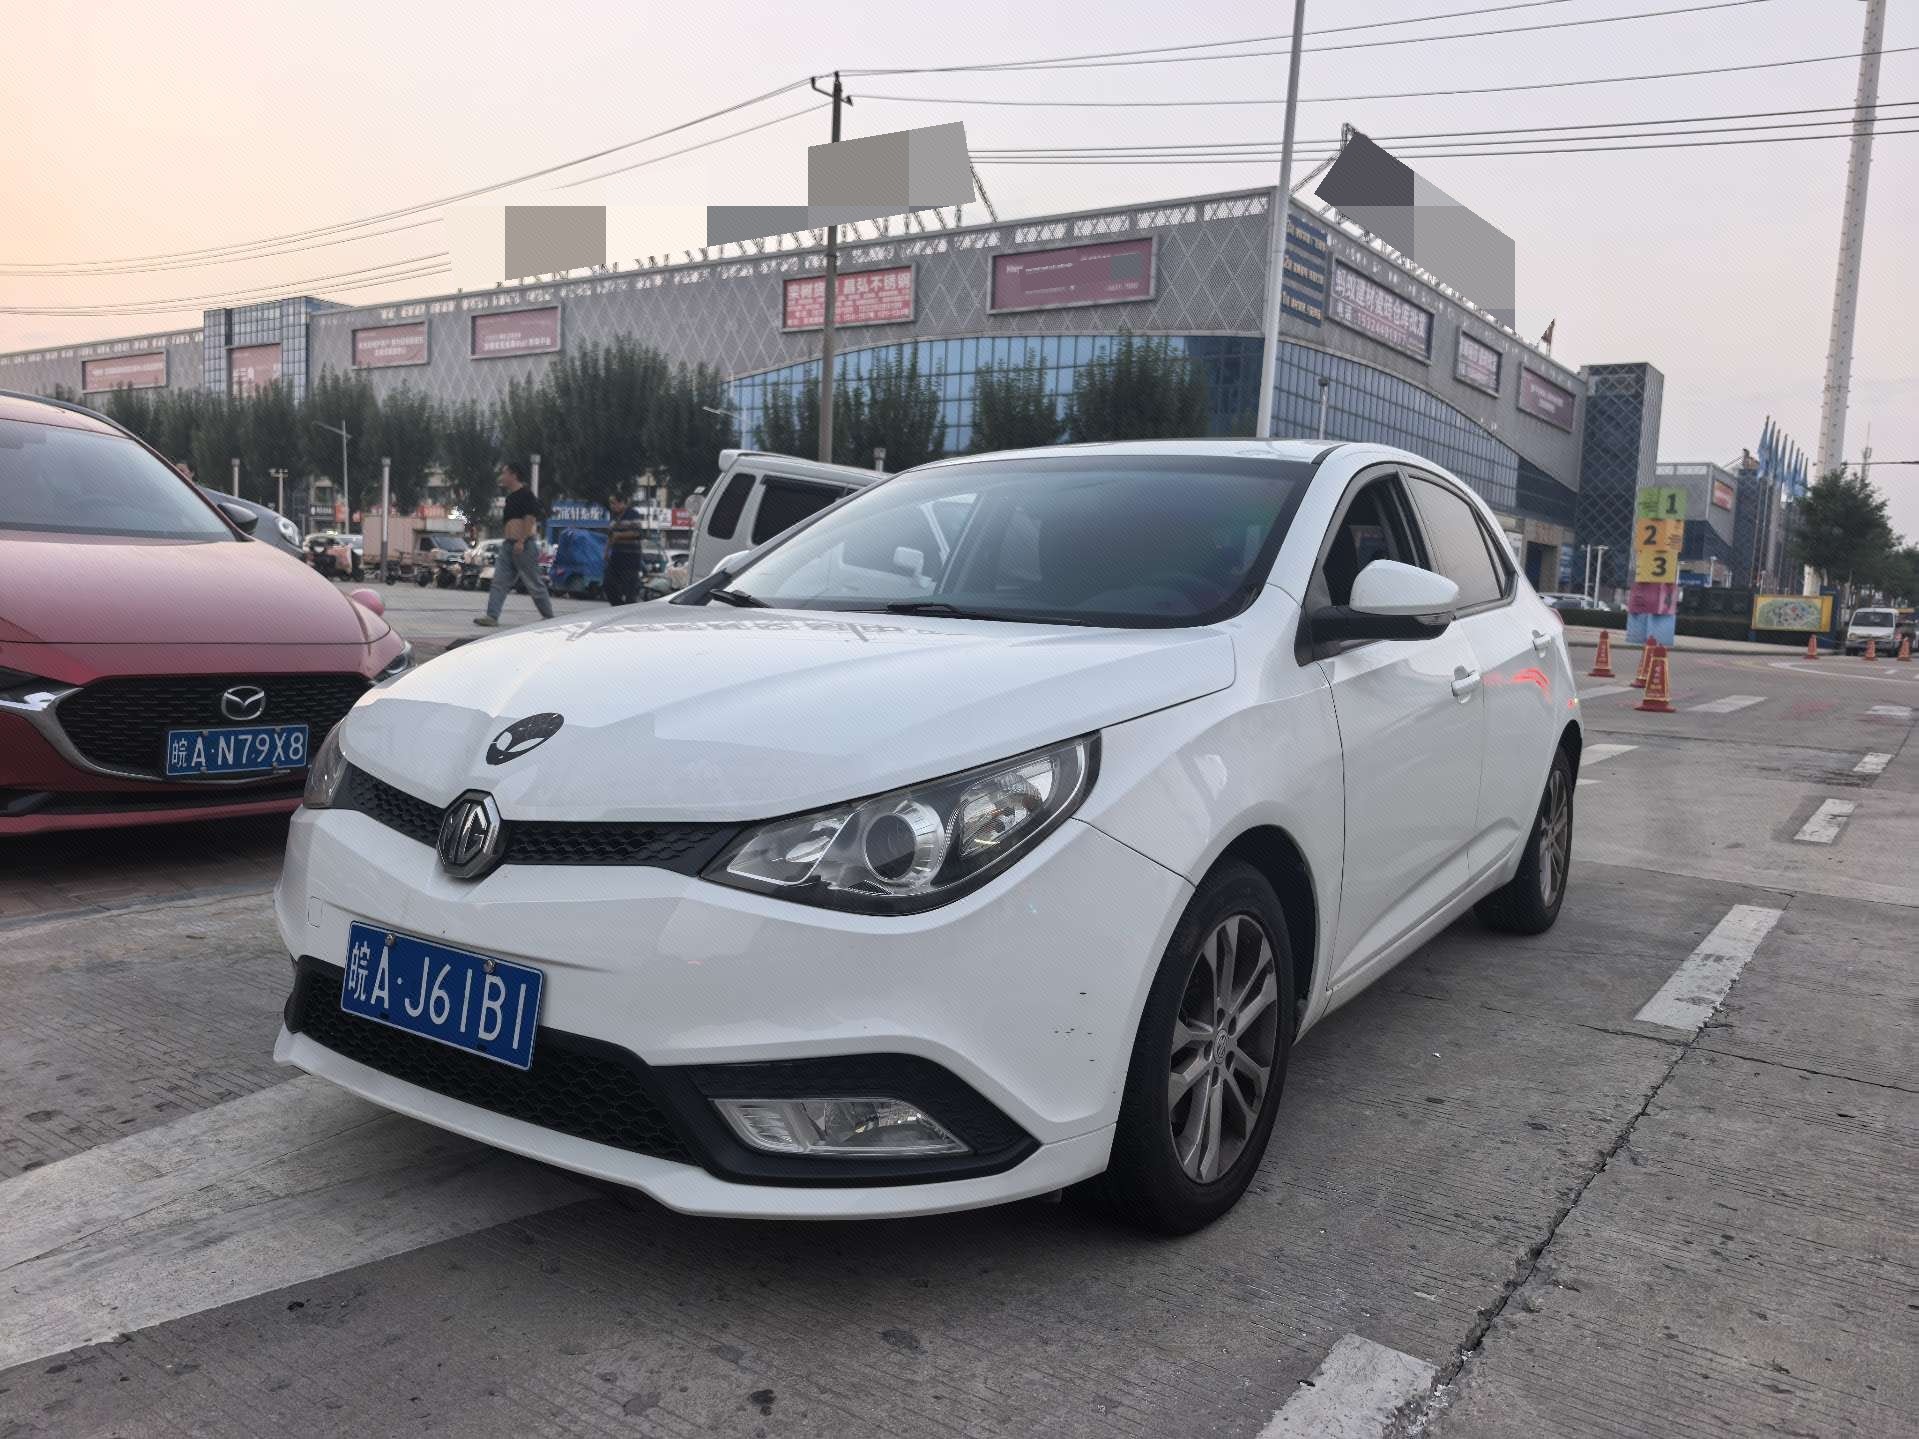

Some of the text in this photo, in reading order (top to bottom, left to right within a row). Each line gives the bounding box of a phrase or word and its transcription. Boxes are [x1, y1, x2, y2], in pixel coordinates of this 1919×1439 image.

[1666, 493, 1678, 514] 1
[1643, 524, 1657, 545] 2
[1651, 557, 1667, 577] 3
[348, 940, 527, 1050] 皖A·J61B1
